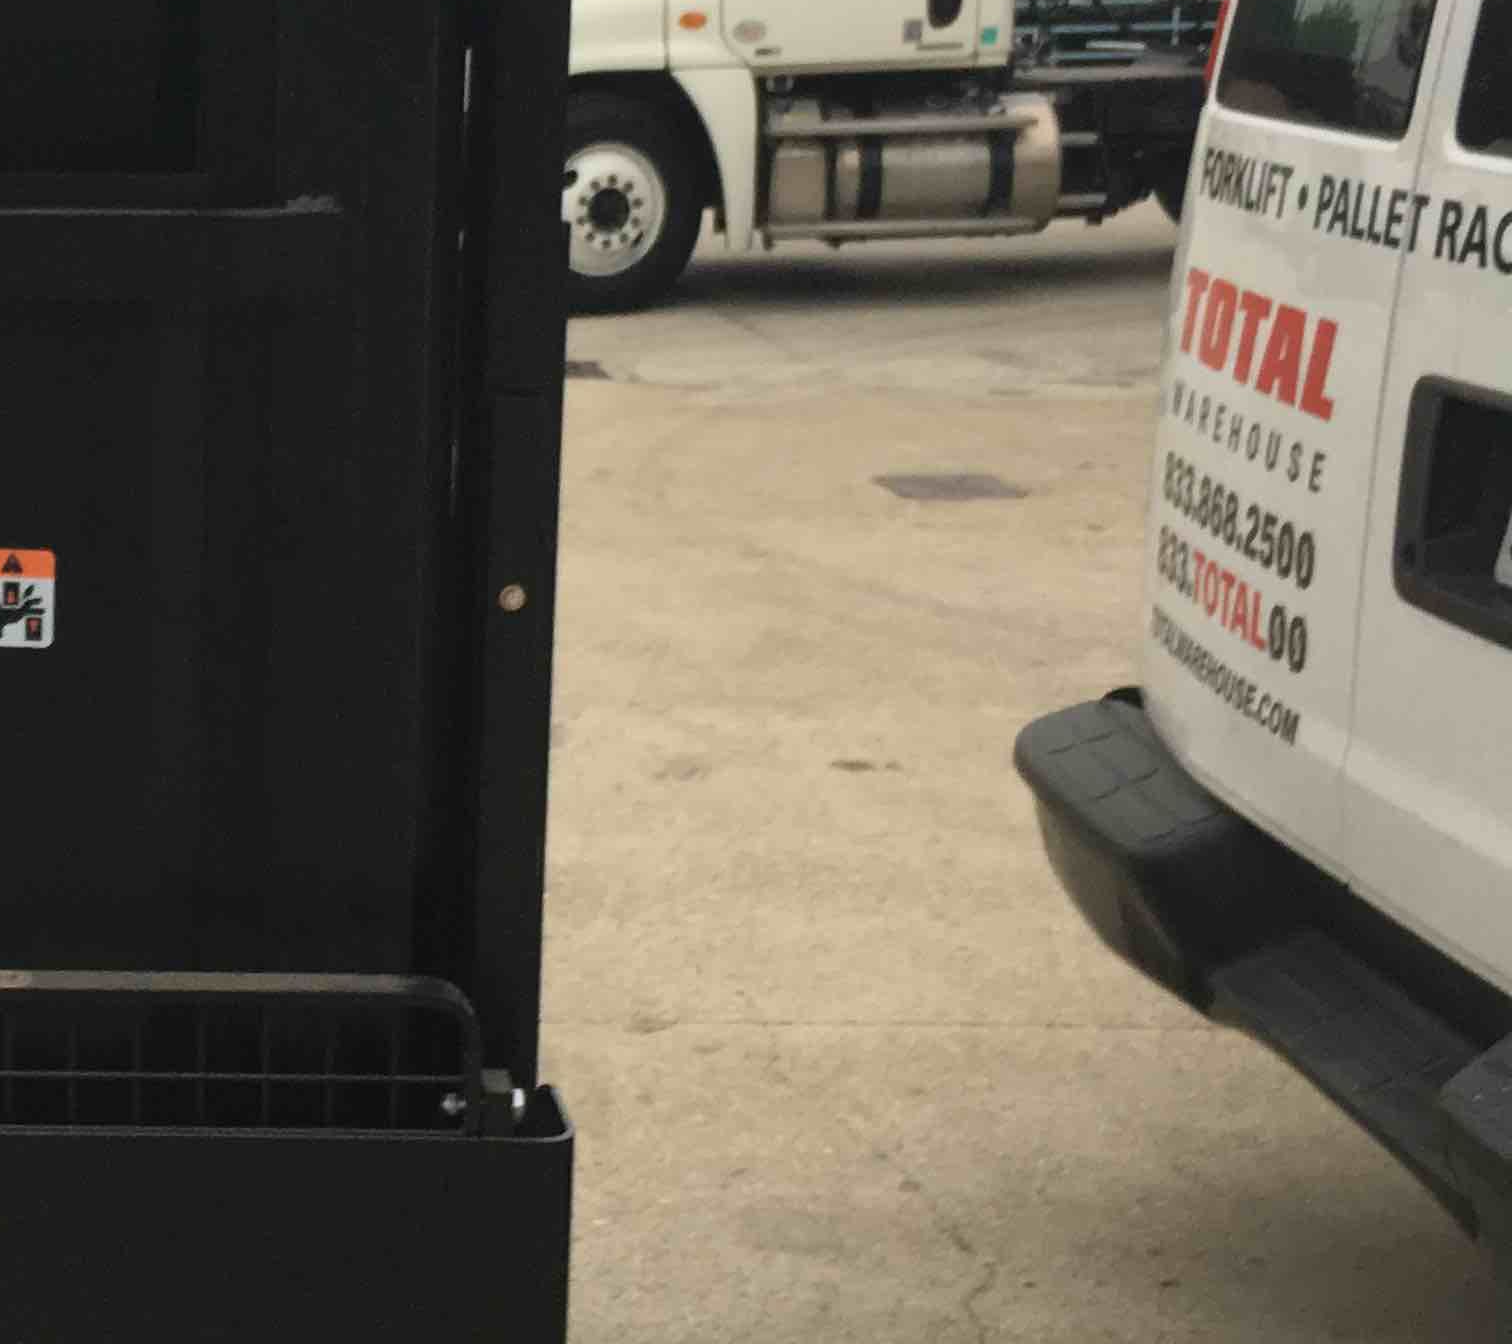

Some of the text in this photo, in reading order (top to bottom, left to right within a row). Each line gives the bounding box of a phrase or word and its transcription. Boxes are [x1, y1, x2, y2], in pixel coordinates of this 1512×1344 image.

[1199, 147, 1294, 220] FORKLIFT
[1313, 173, 1431, 254] PALLET
[1180, 267, 1338, 423] TOTAL
[1172, 380, 1327, 494] WAREHOUSE
[1162, 450, 1315, 590] 833.868.2500
[1157, 523, 1308, 674] 833.TOTAL00
[1152, 603, 1300, 746] TOTALWAREHOUSE.COM
